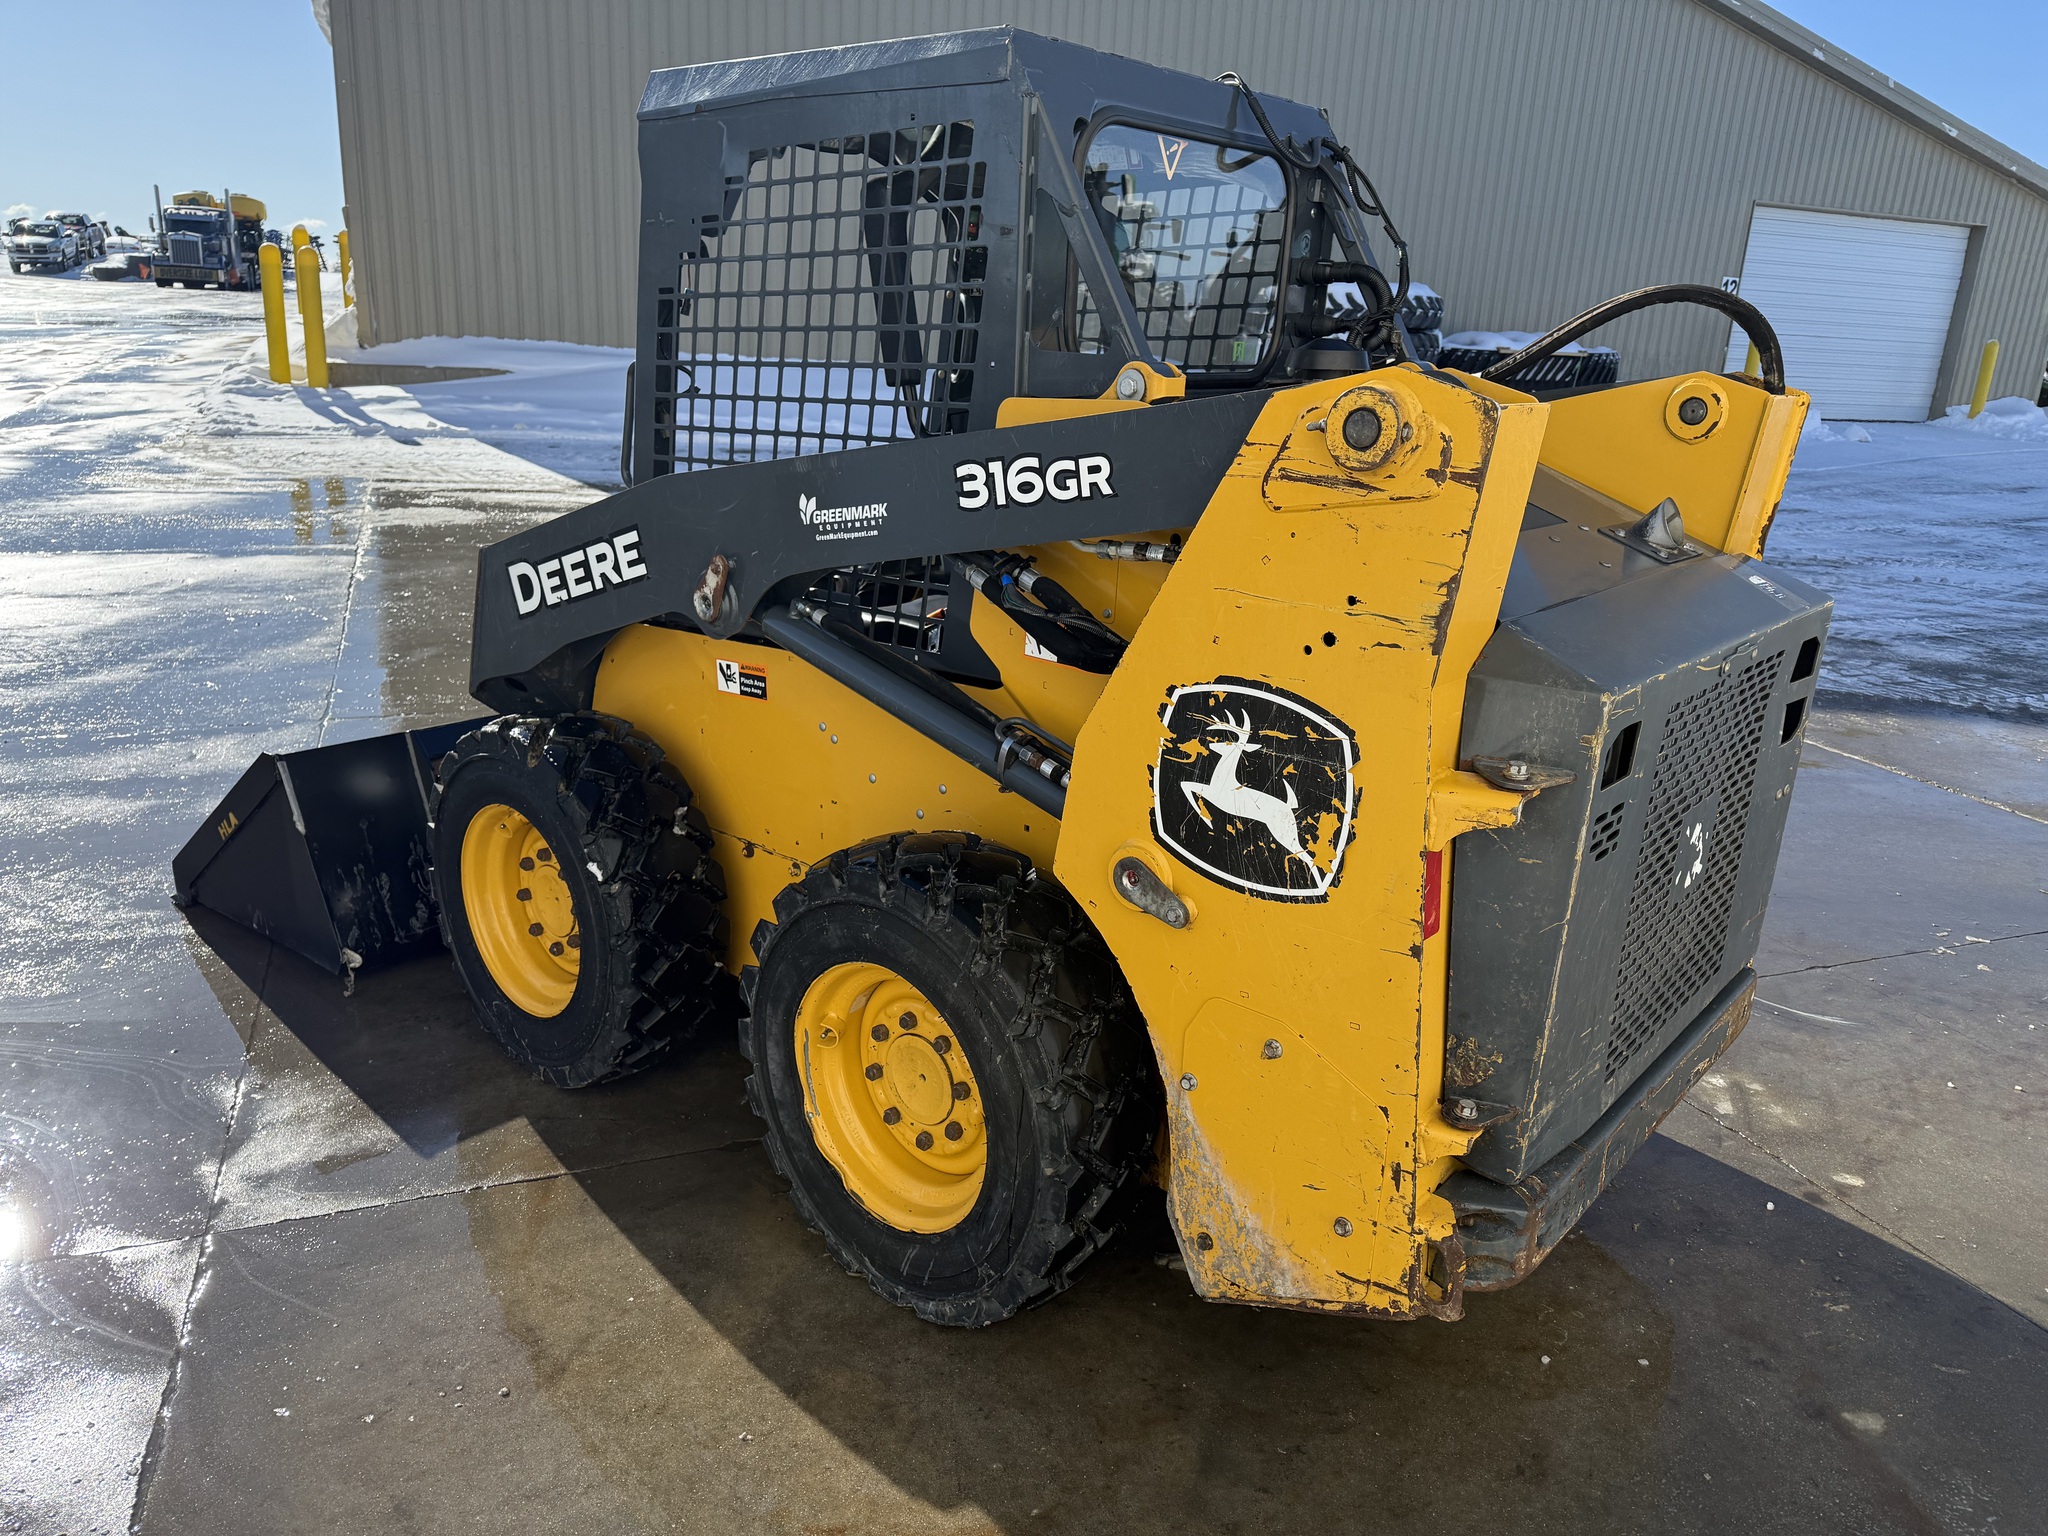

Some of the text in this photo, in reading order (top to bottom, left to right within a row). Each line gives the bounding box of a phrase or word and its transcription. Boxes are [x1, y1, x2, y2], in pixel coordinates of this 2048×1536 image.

[1722, 279, 1738, 293] 12
[955, 455, 1114, 509] 316GR
[812, 502, 888, 524] GREENMARK
[818, 518, 883, 532] EQUIPMENT
[815, 529, 879, 541] GreenMarkEquipment.com
[507, 529, 648, 615] DEERE
[740, 677, 766, 688] Pinch Area
[741, 685, 763, 696] Keep Away
[217, 811, 239, 841] HLA
